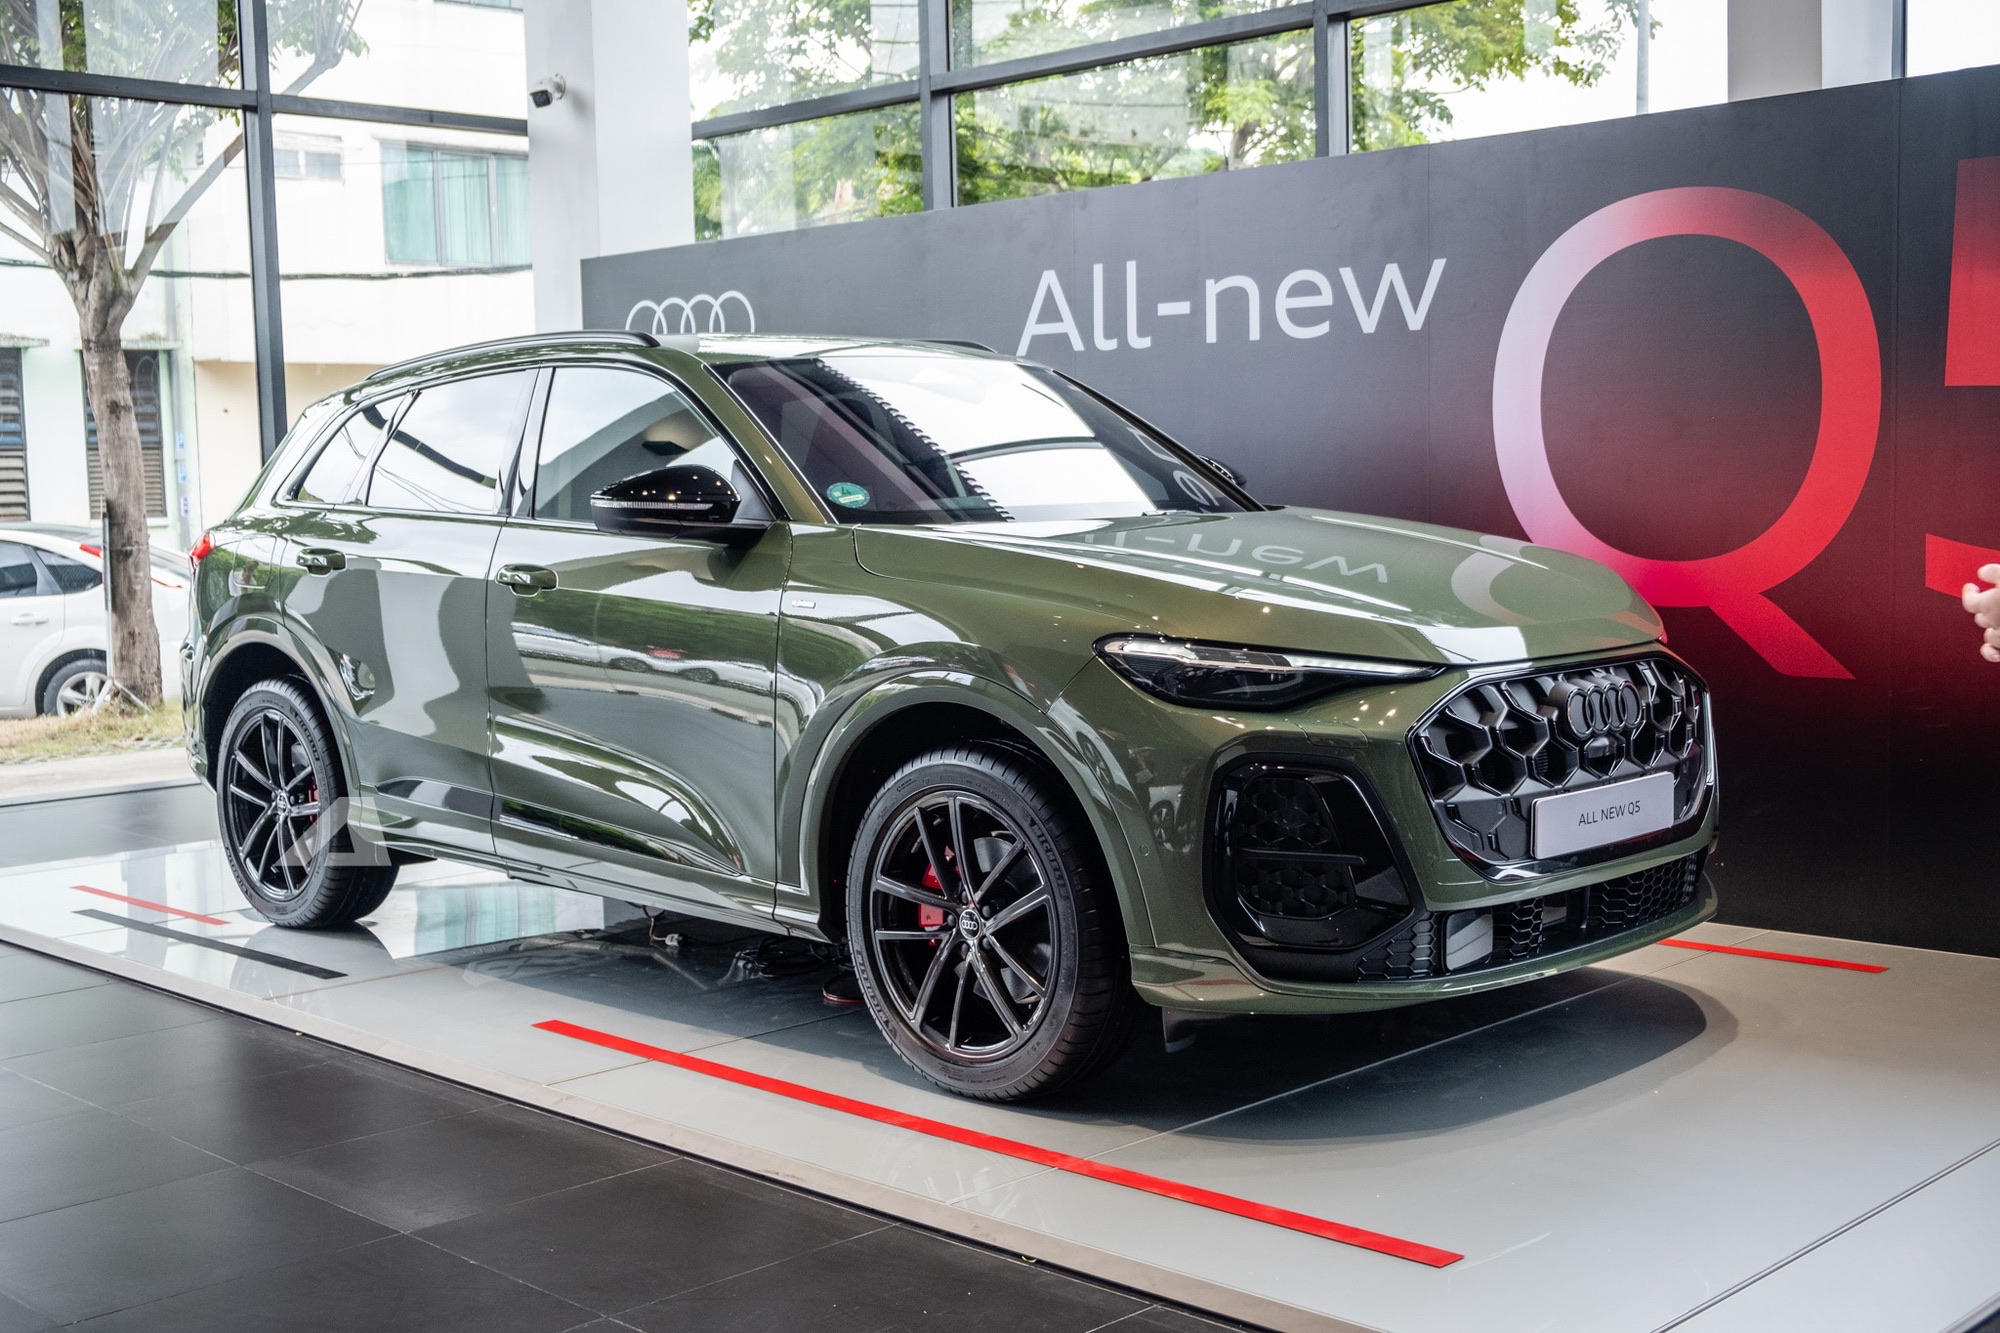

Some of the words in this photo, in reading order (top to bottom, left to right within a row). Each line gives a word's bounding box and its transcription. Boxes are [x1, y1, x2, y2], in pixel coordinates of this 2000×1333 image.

[1016, 258, 1447, 357] All-new
[1578, 811, 1598, 826] ALL
[1601, 804, 1626, 821] NEW
[1627, 800, 1641, 816] Q5
